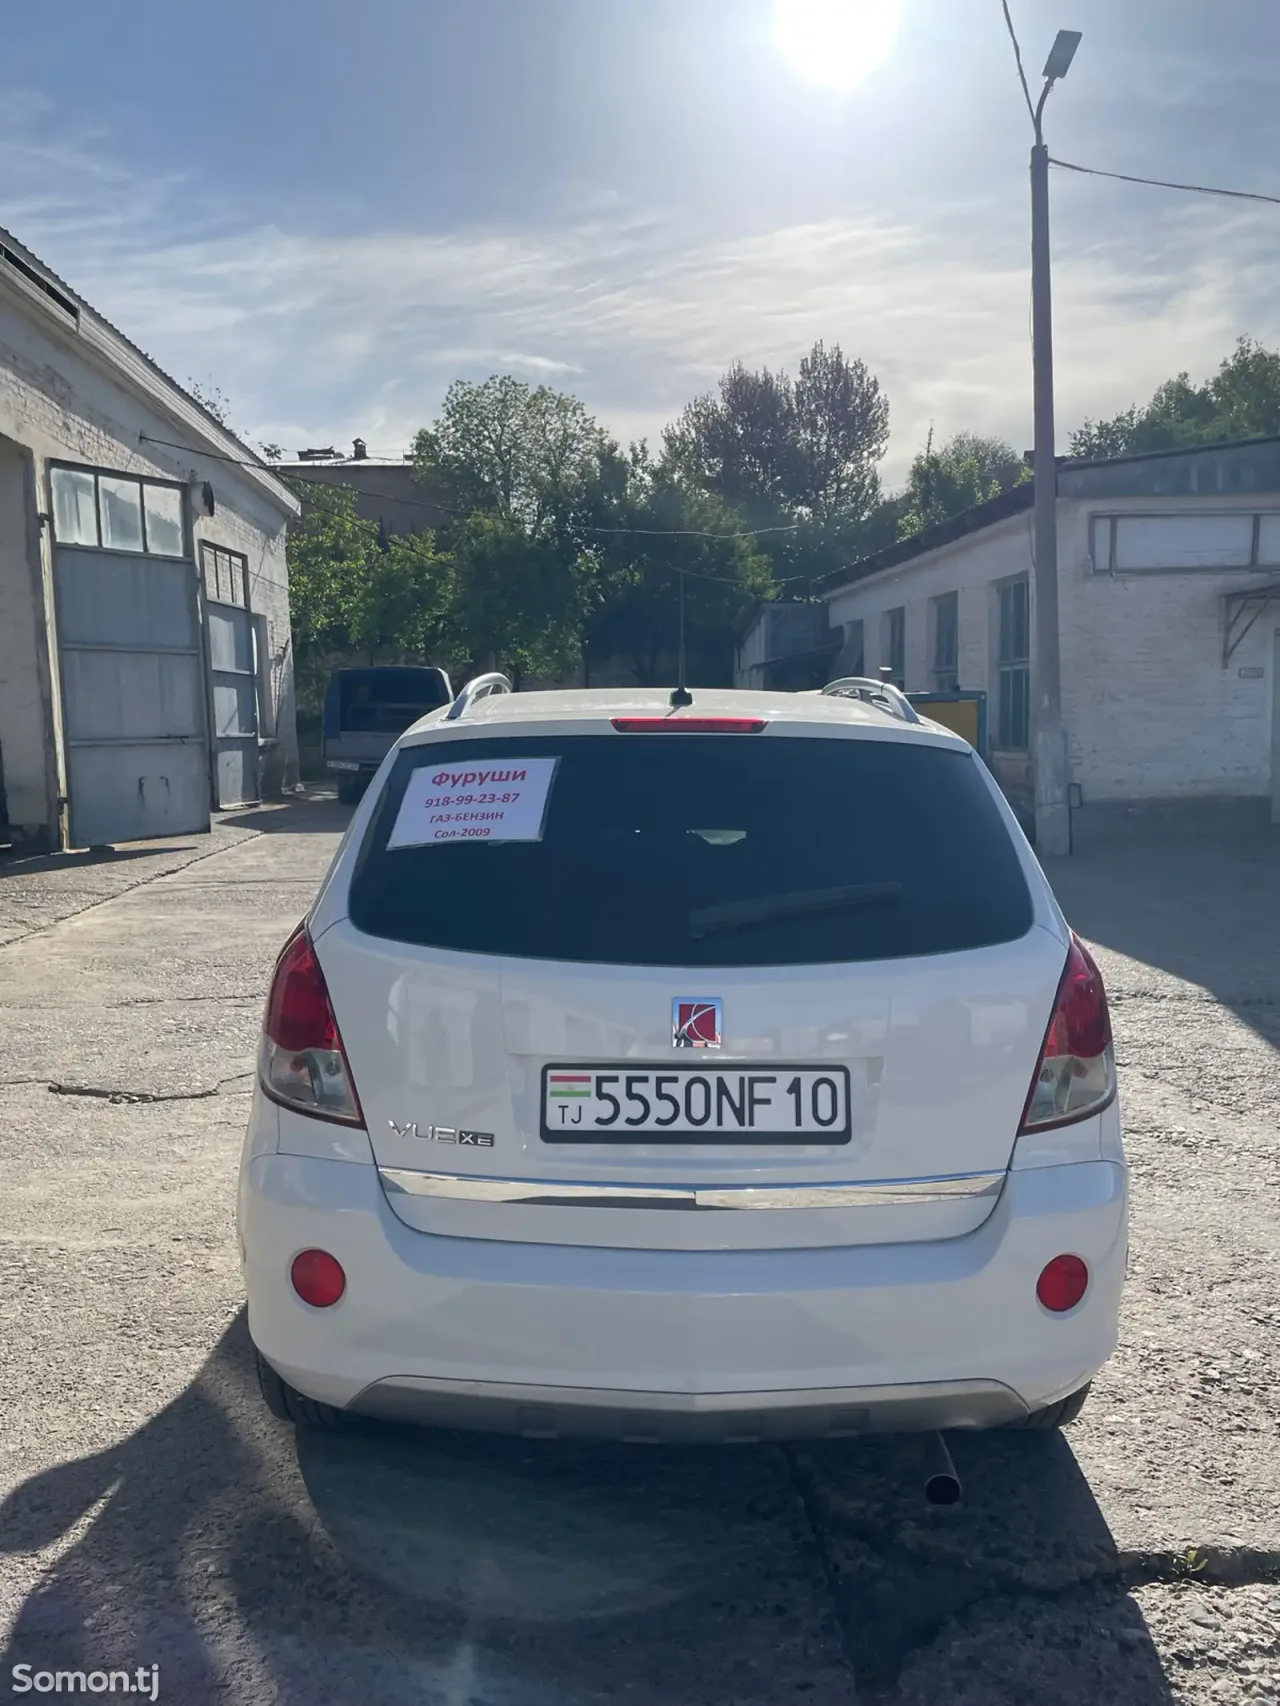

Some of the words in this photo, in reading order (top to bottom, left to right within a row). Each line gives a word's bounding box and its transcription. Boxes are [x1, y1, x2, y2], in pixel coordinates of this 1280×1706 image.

[432, 770, 526, 788] Фуруши
[424, 793, 520, 808] 918-99-23-87
[429, 812, 504, 823] ГАЗ-БЕНЗИН
[434, 828, 490, 838] Сол-2009
[558, 1105, 582, 1124] TJ
